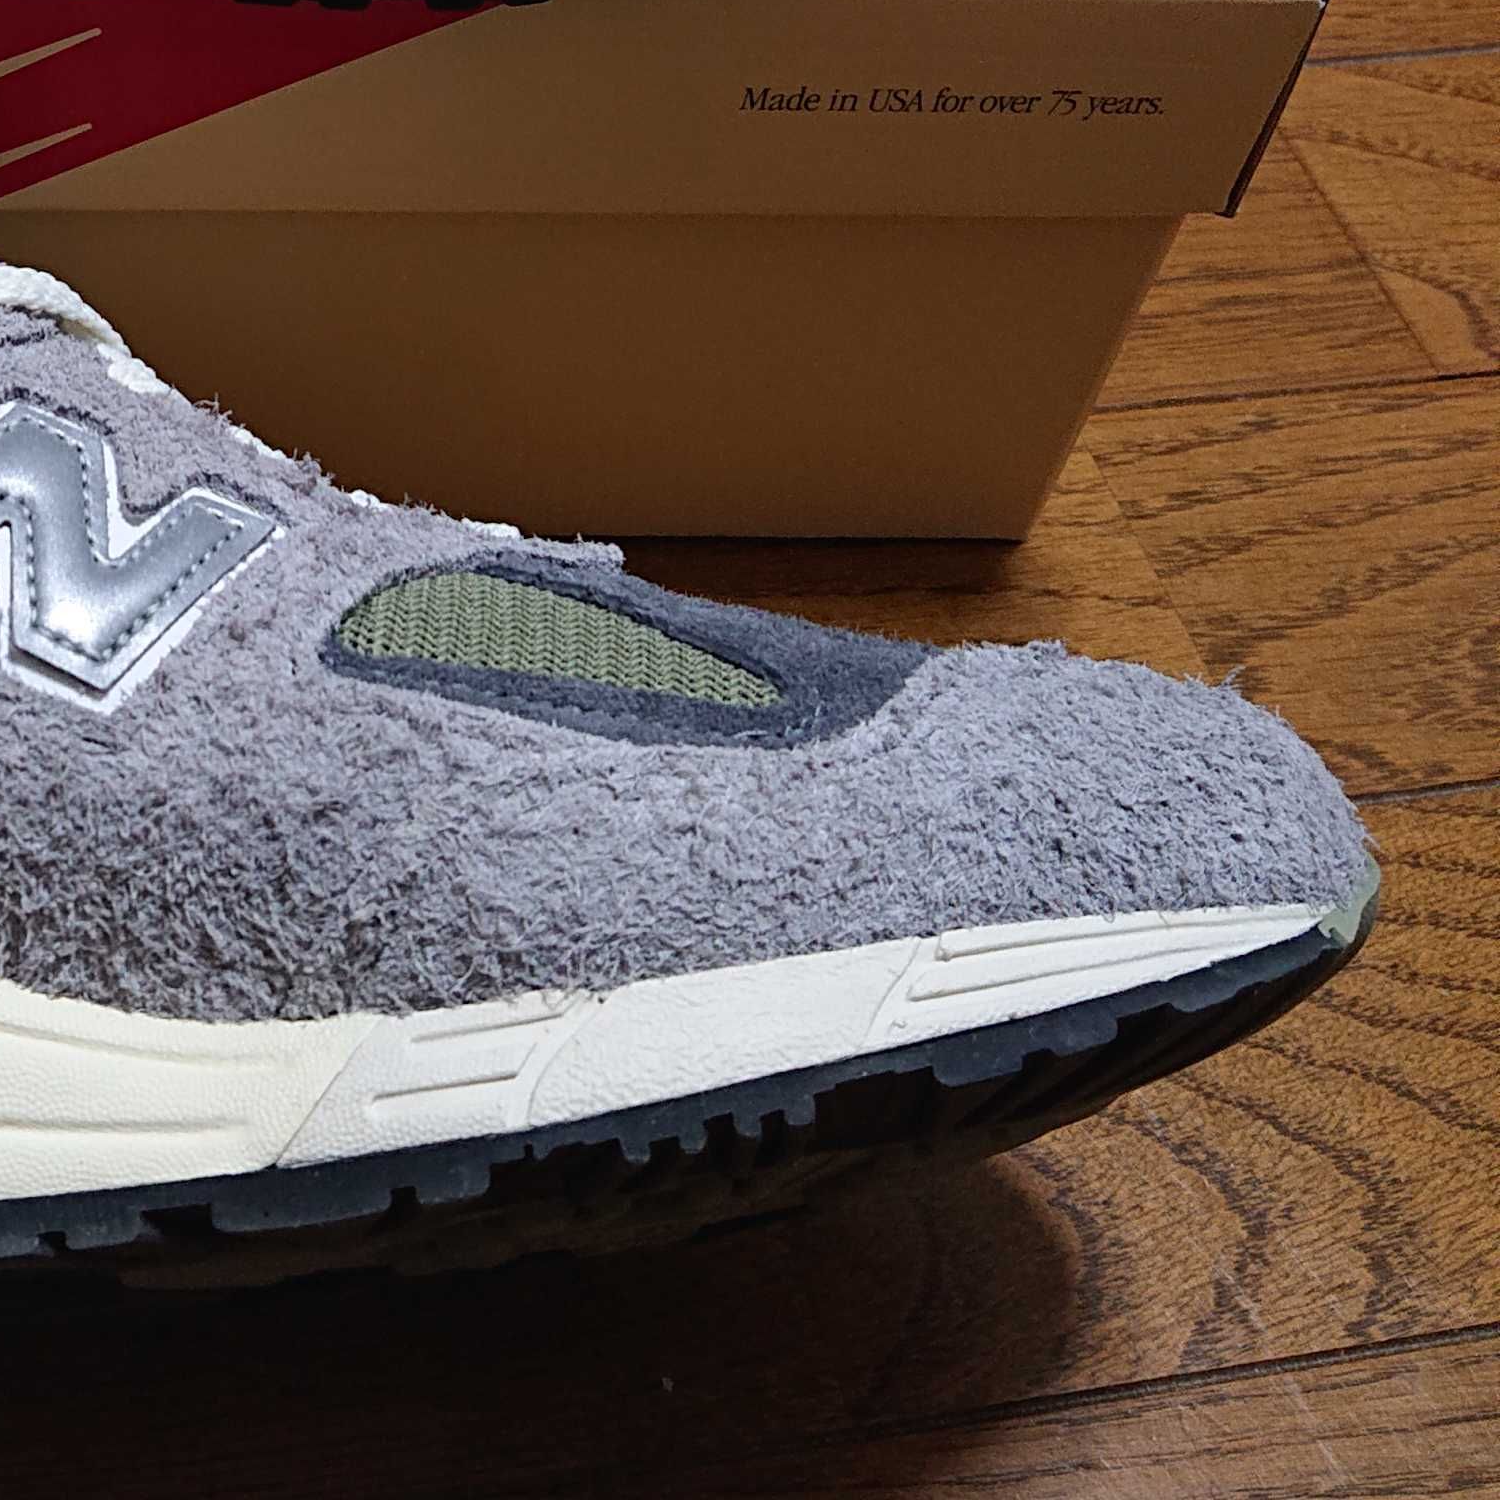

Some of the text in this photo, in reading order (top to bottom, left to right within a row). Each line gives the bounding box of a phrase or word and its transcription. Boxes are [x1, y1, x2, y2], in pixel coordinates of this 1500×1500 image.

[738, 86, 1165, 120] Made in USA for over 75 years.
